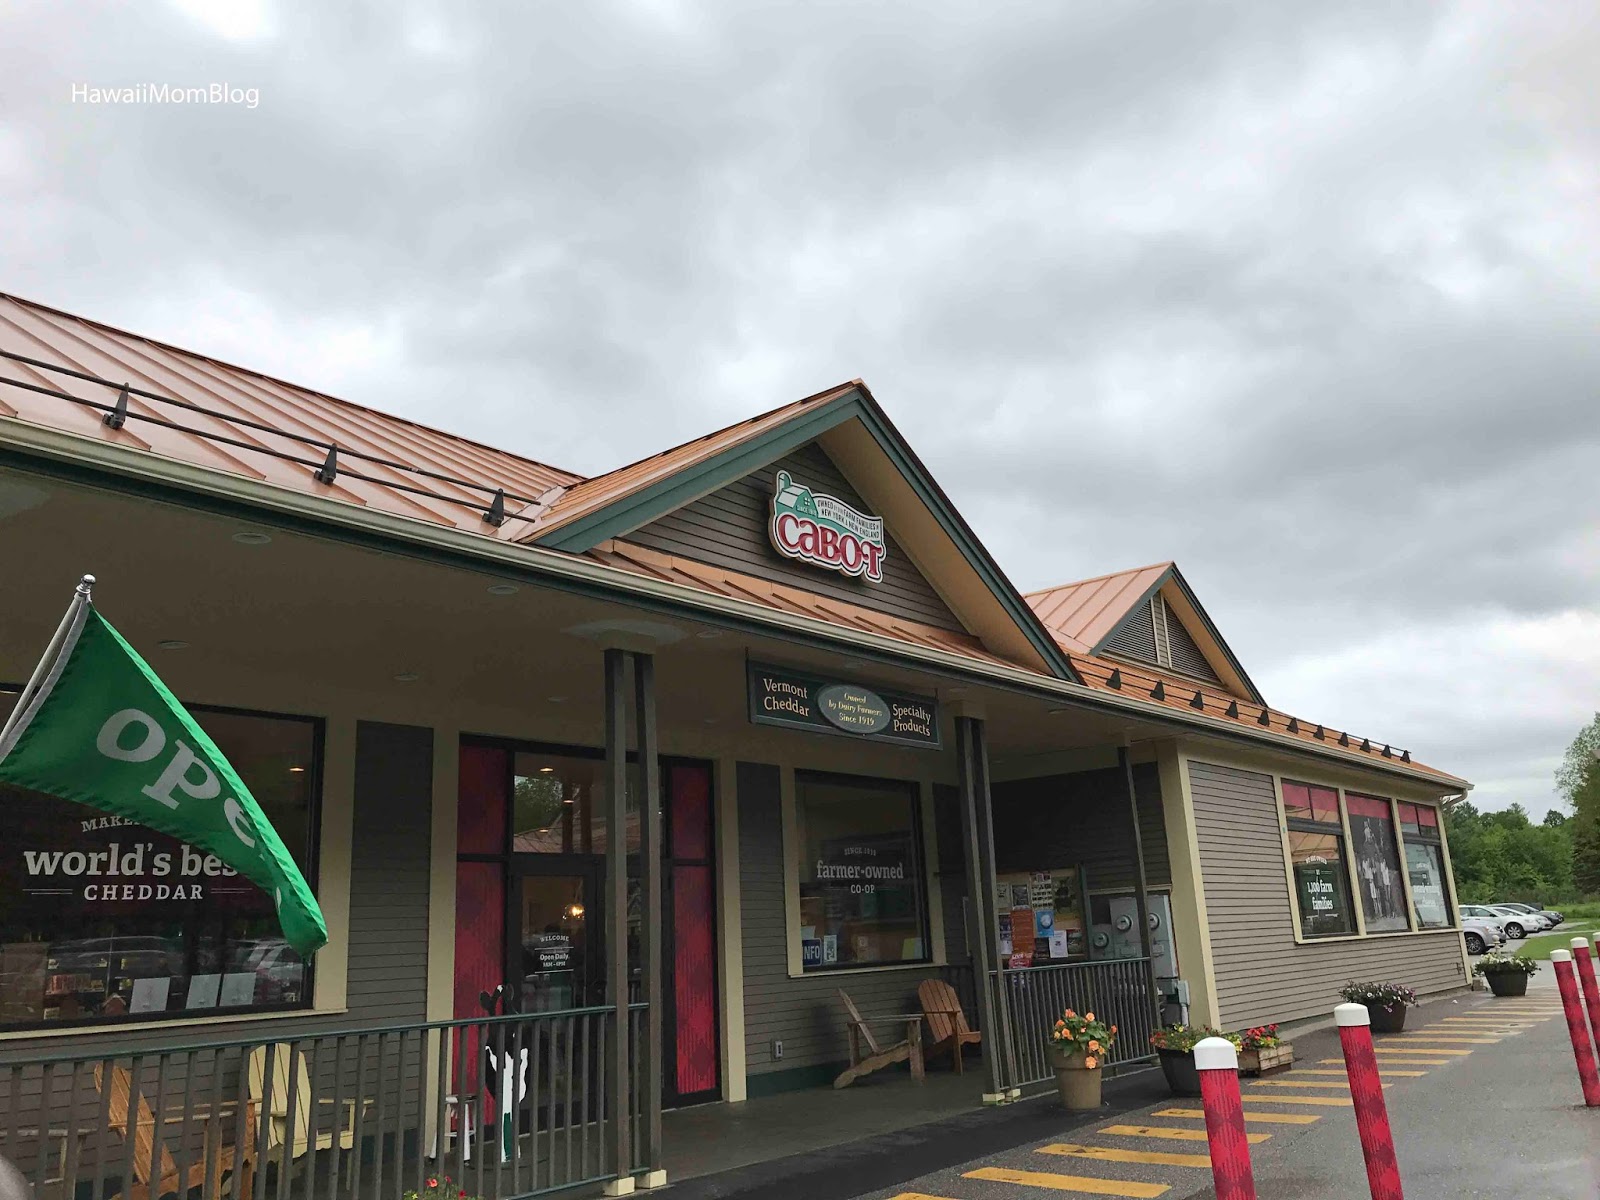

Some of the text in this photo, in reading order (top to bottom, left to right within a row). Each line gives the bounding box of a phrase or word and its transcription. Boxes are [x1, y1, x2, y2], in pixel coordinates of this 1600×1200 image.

[817, 499, 834, 510] OWNED
[843, 509, 856, 522] FARM
[856, 516, 876, 530] FAMILIES
[821, 509, 832, 517] NEW
[832, 512, 845, 524] YORK
[848, 520, 860, 532] NEW
[859, 527, 880, 539] ENGLAND
[763, 678, 808, 699] Vermont
[764, 696, 810, 717] Cheddar
[844, 692, 867, 704] Owned
[828, 699, 883, 717] by Dairy Farmers
[892, 703, 932, 725] Specialty
[838, 712, 875, 726] Since 1919
[893, 719, 931, 737] Products
[81, 815, 141, 832] MAKE
[23, 843, 239, 877] world's bes
[84, 884, 203, 901] CHEDDAR
[850, 884, 875, 894] CO-OP
[1319, 879, 1334, 893] farm
[1312, 896, 1334, 910] families
[540, 953, 568, 962] Open Daily
[803, 945, 820, 960] NFO
